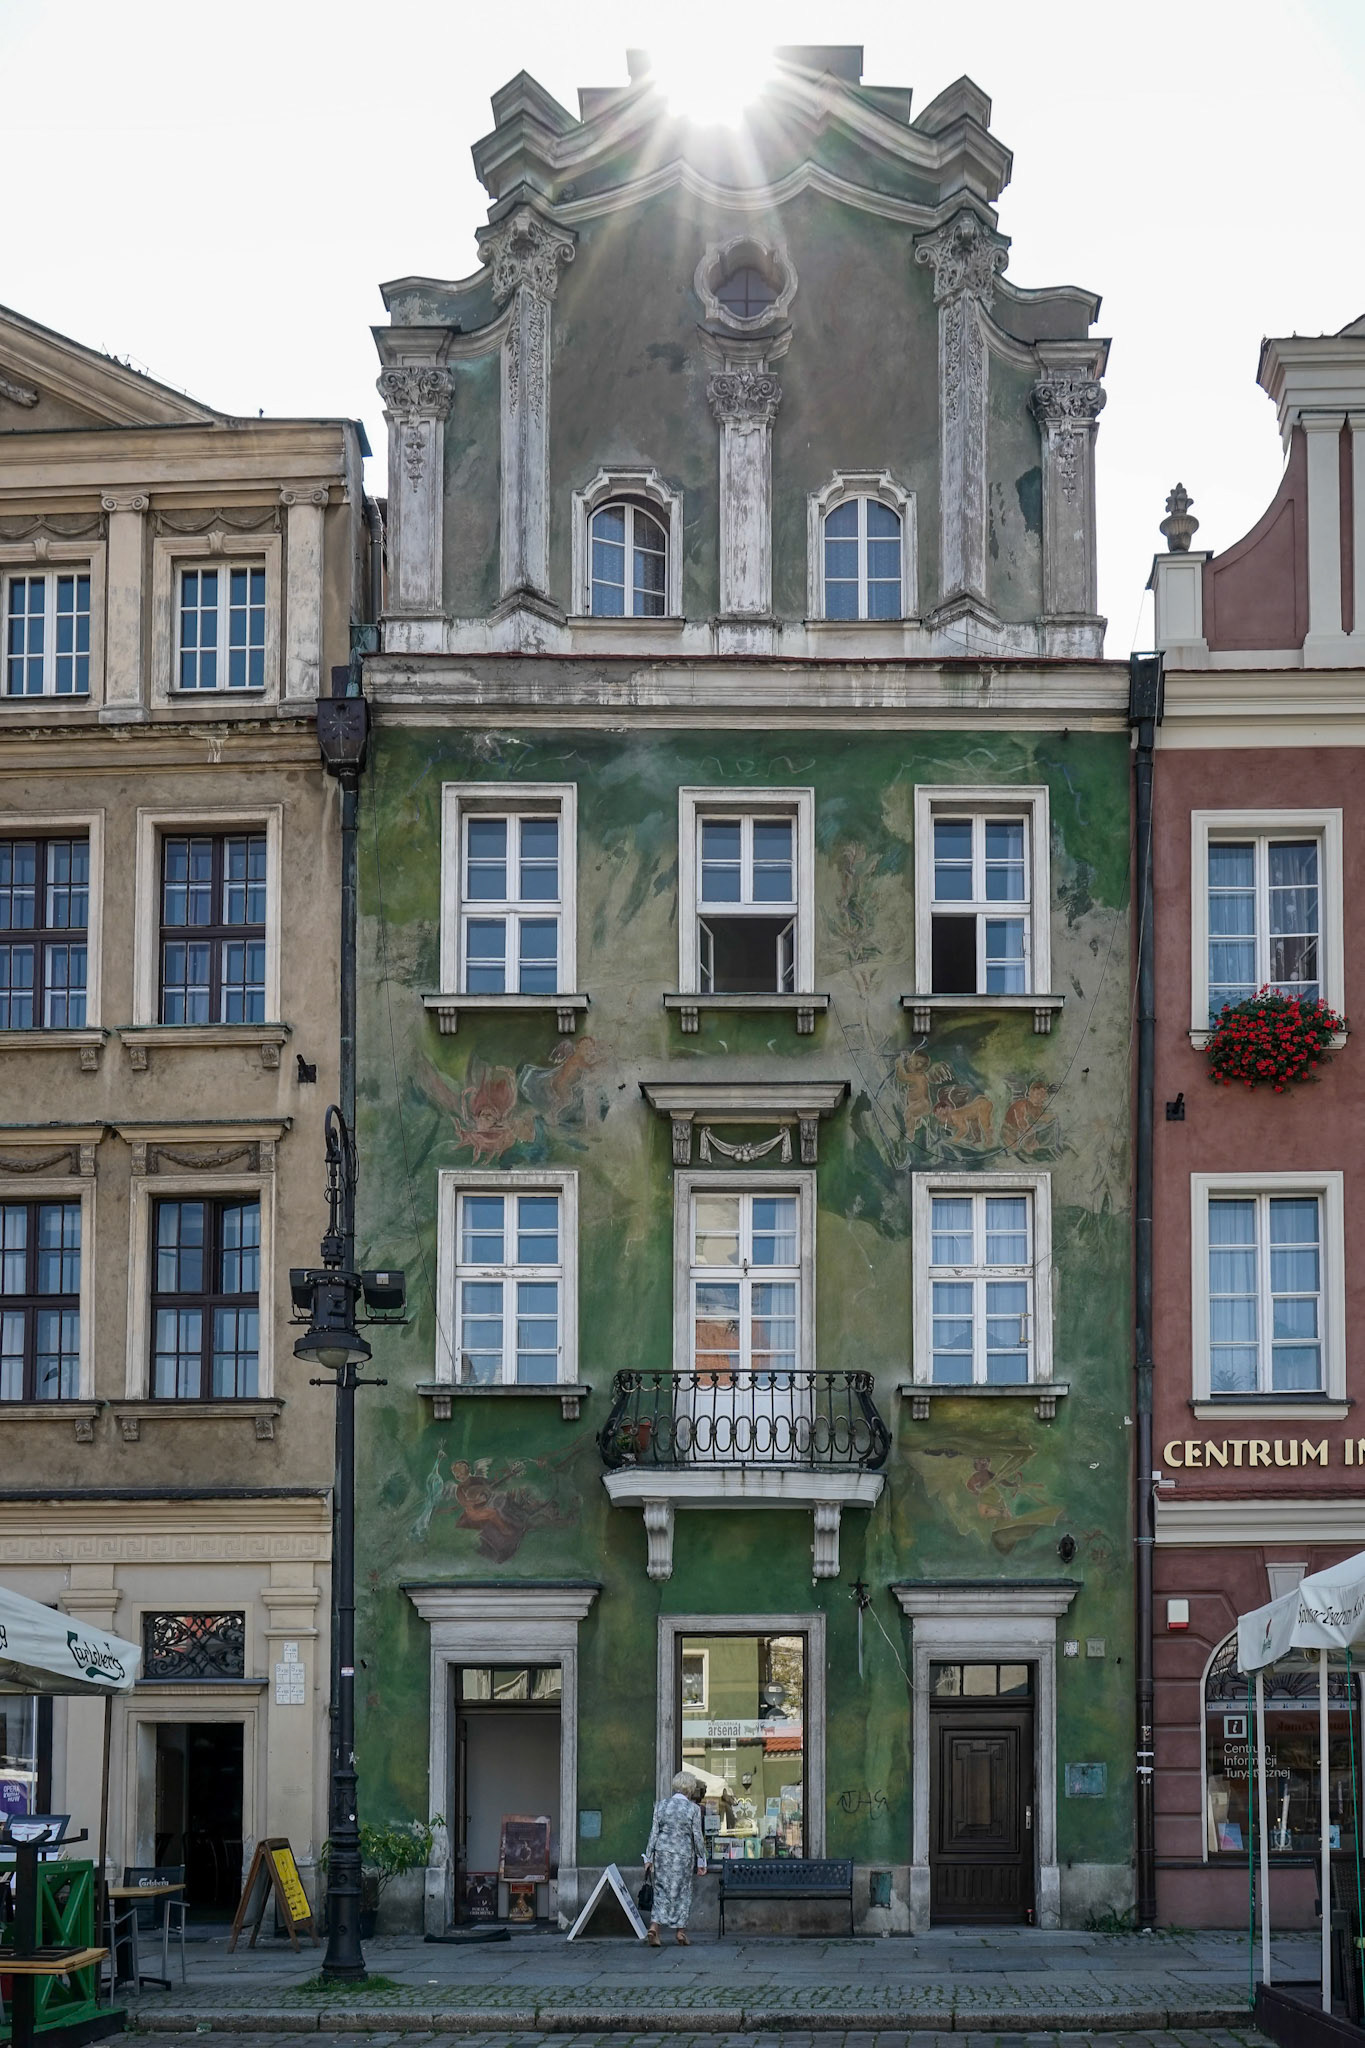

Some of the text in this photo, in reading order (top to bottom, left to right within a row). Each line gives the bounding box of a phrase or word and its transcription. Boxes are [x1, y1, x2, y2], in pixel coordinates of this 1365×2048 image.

[1163, 1439, 1329, 1467] CENTRUM
[66, 1630, 126, 1680] Carlsberg
[1224, 1743, 1271, 1754] Centum
[1223, 1755, 1277, 1767] Informcji
[1224, 1767, 1291, 1780] Turystcznej
[138, 1877, 170, 1888] Carlsberg
